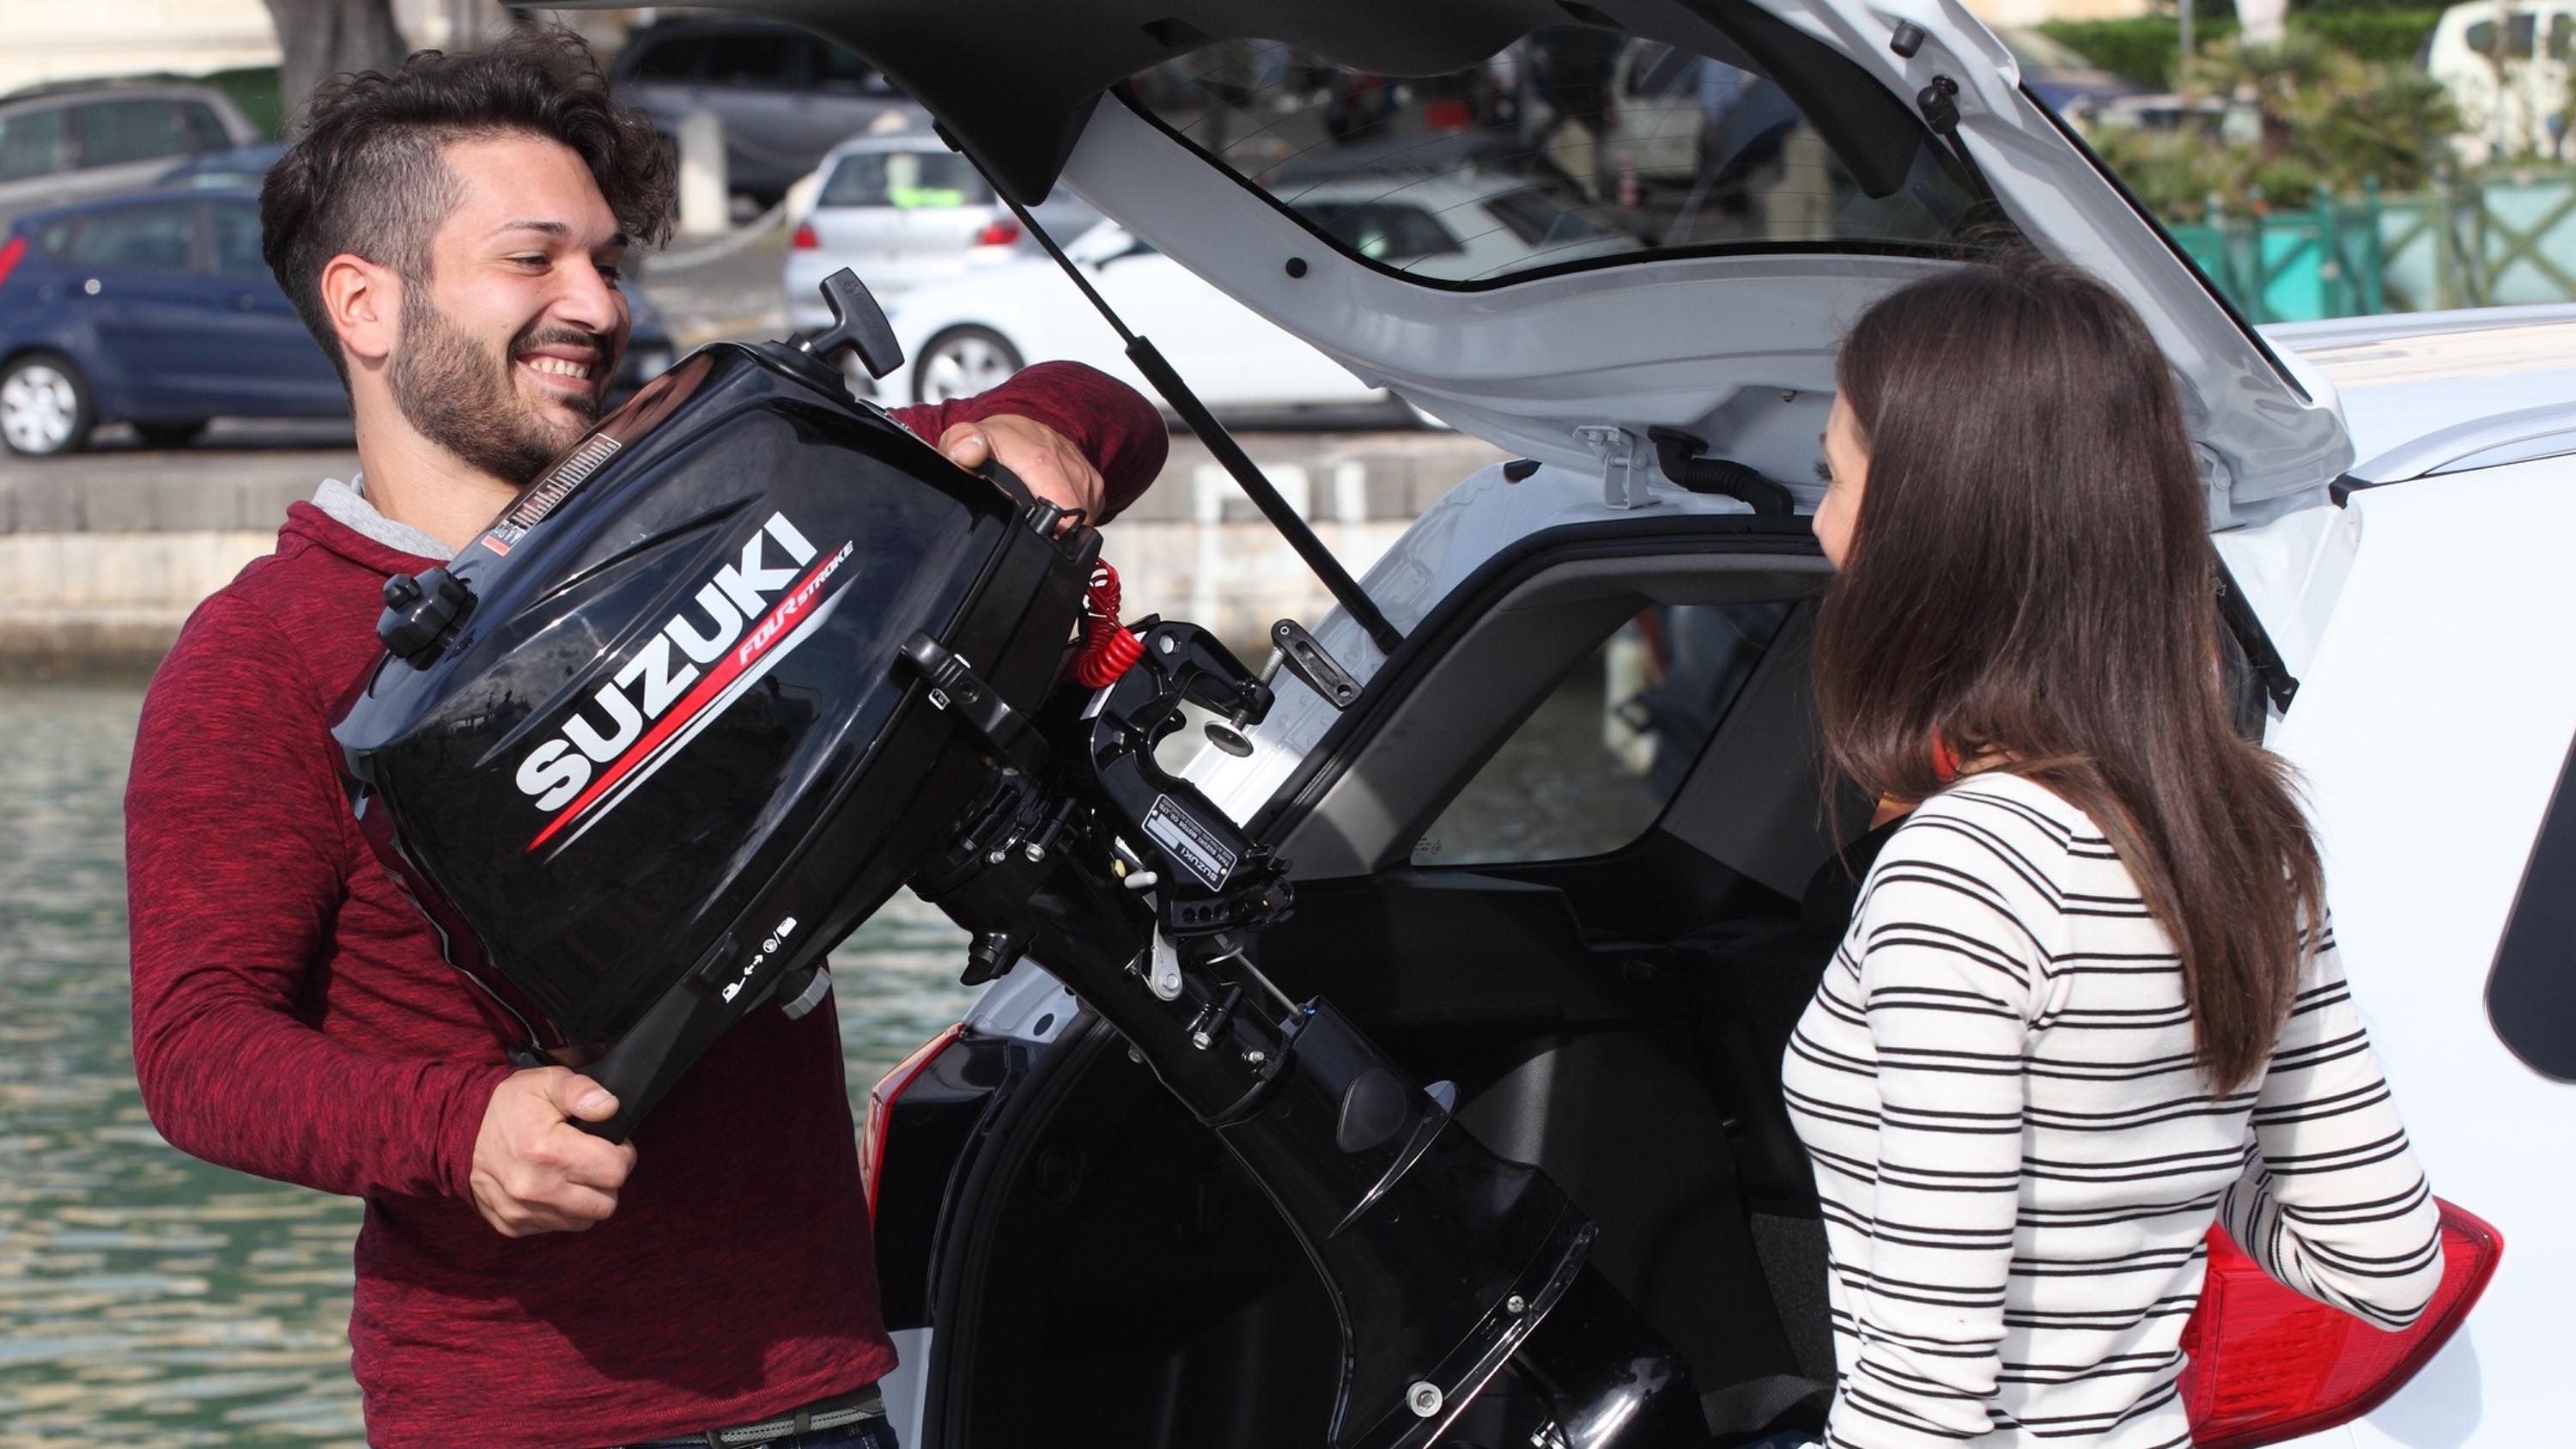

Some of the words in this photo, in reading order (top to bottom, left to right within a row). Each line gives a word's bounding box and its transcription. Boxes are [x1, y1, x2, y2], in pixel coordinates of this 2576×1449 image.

[739, 597, 798, 666] FOUR
[797, 540, 854, 607] STROKE
[516, 511, 818, 812] SUZUKI
[1179, 820, 1197, 839] MOTOR
[1197, 837, 1217, 855] SUZUKI
[1215, 852, 1230, 867] THAI
[1179, 846, 1218, 882] SUZUKI
